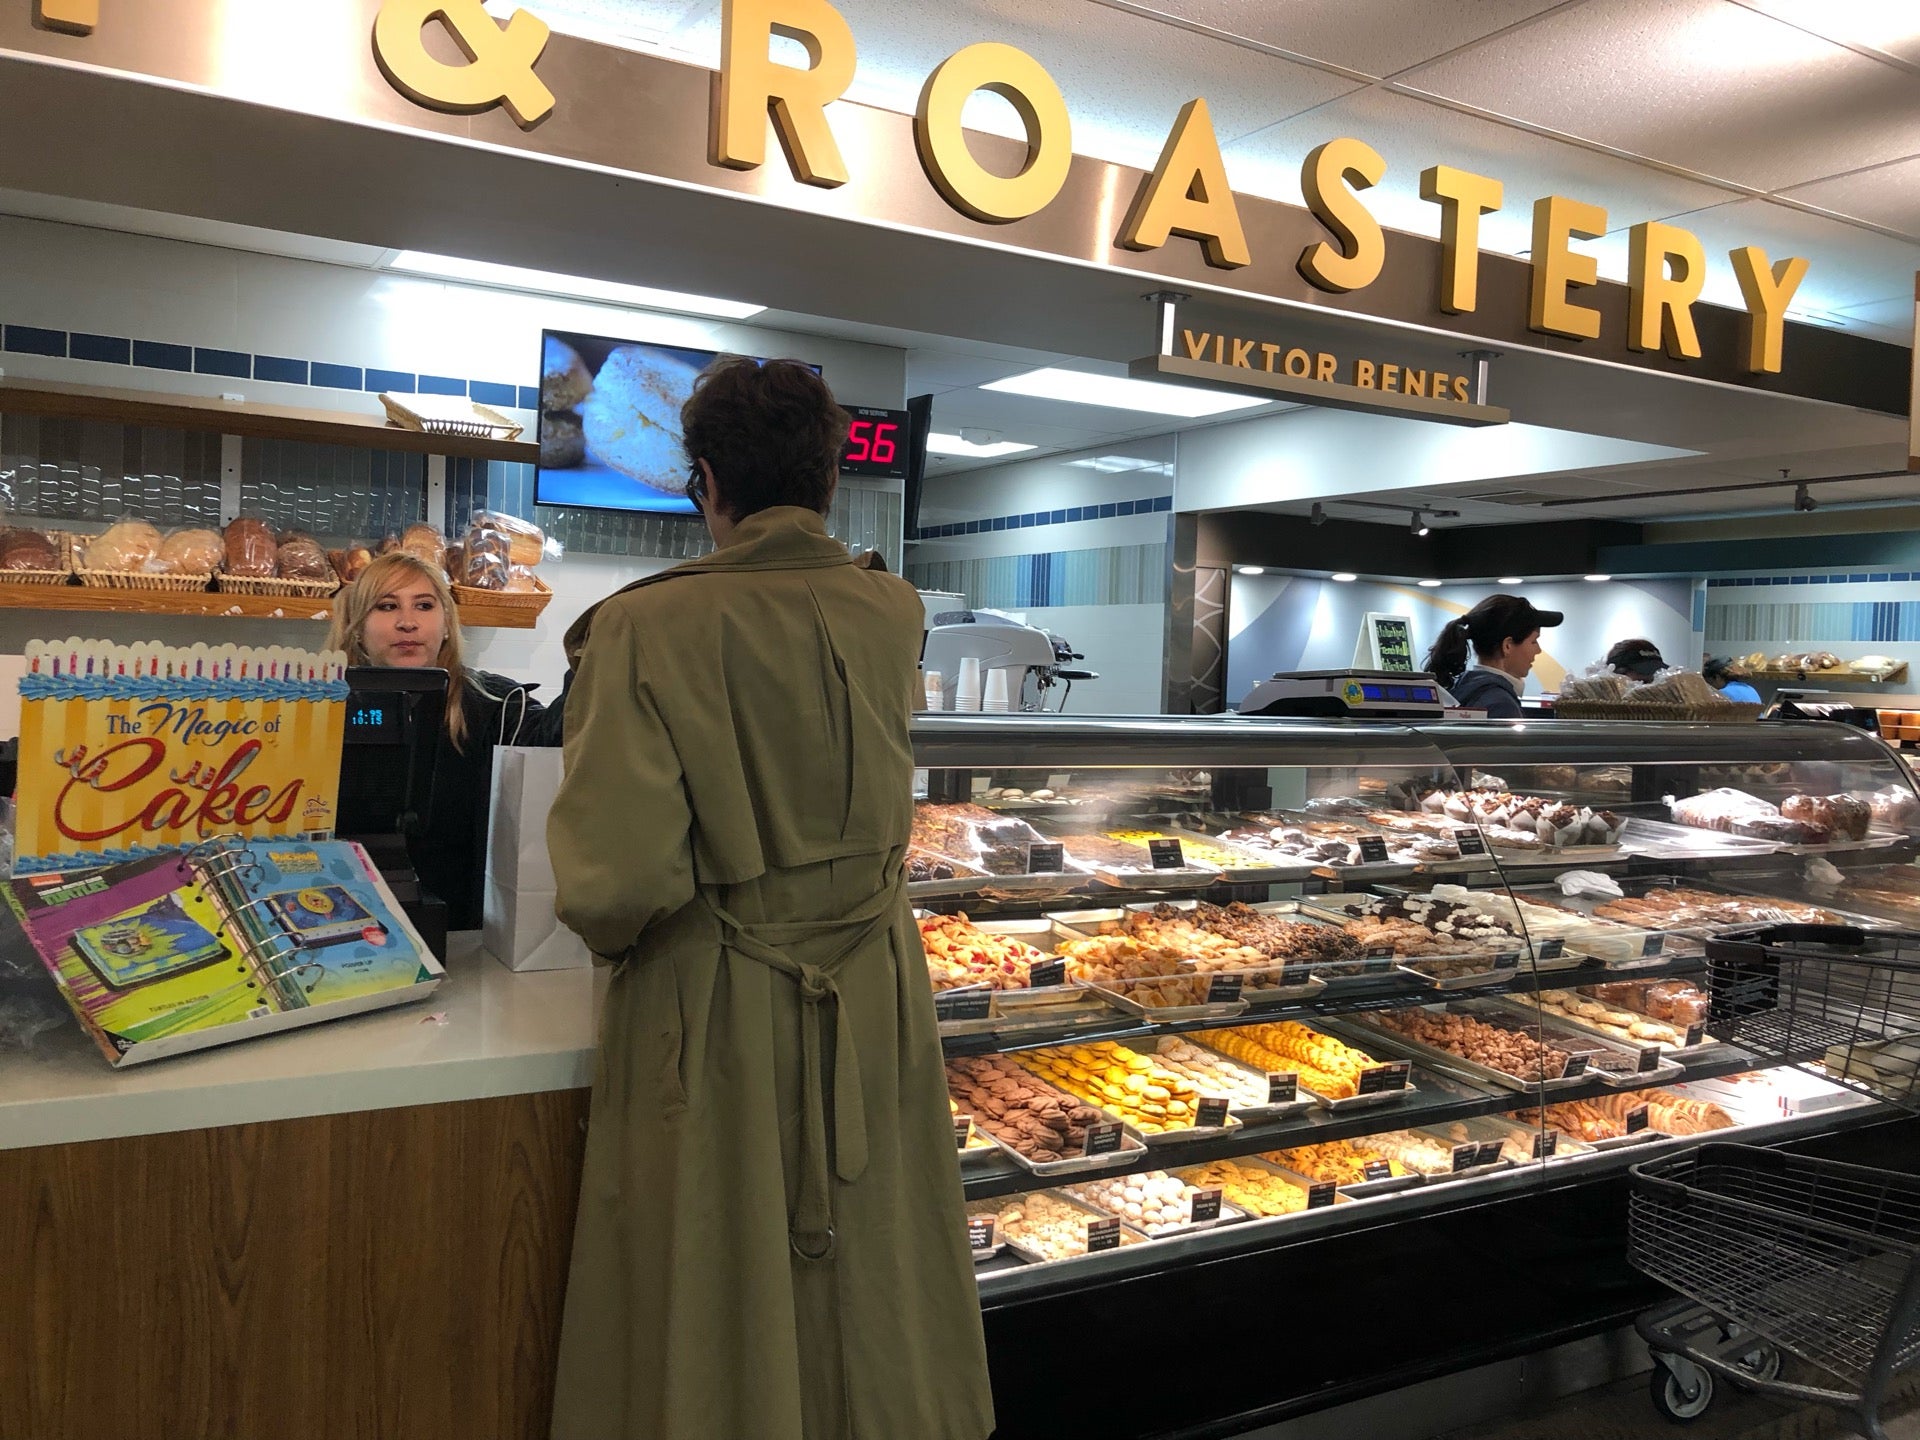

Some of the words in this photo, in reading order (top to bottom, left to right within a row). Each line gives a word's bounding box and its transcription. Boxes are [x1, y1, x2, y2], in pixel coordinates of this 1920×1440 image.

[718, 0, 1811, 375] ROASTERY
[1182, 328, 1339, 384] VIKTOR
[1354, 359, 1470, 404] BENES
[846, 421, 898, 463] 56
[106, 714, 142, 734] The
[137, 702, 259, 746] Magic
[263, 714, 282, 733] of
[54, 737, 305, 842] Cakes
